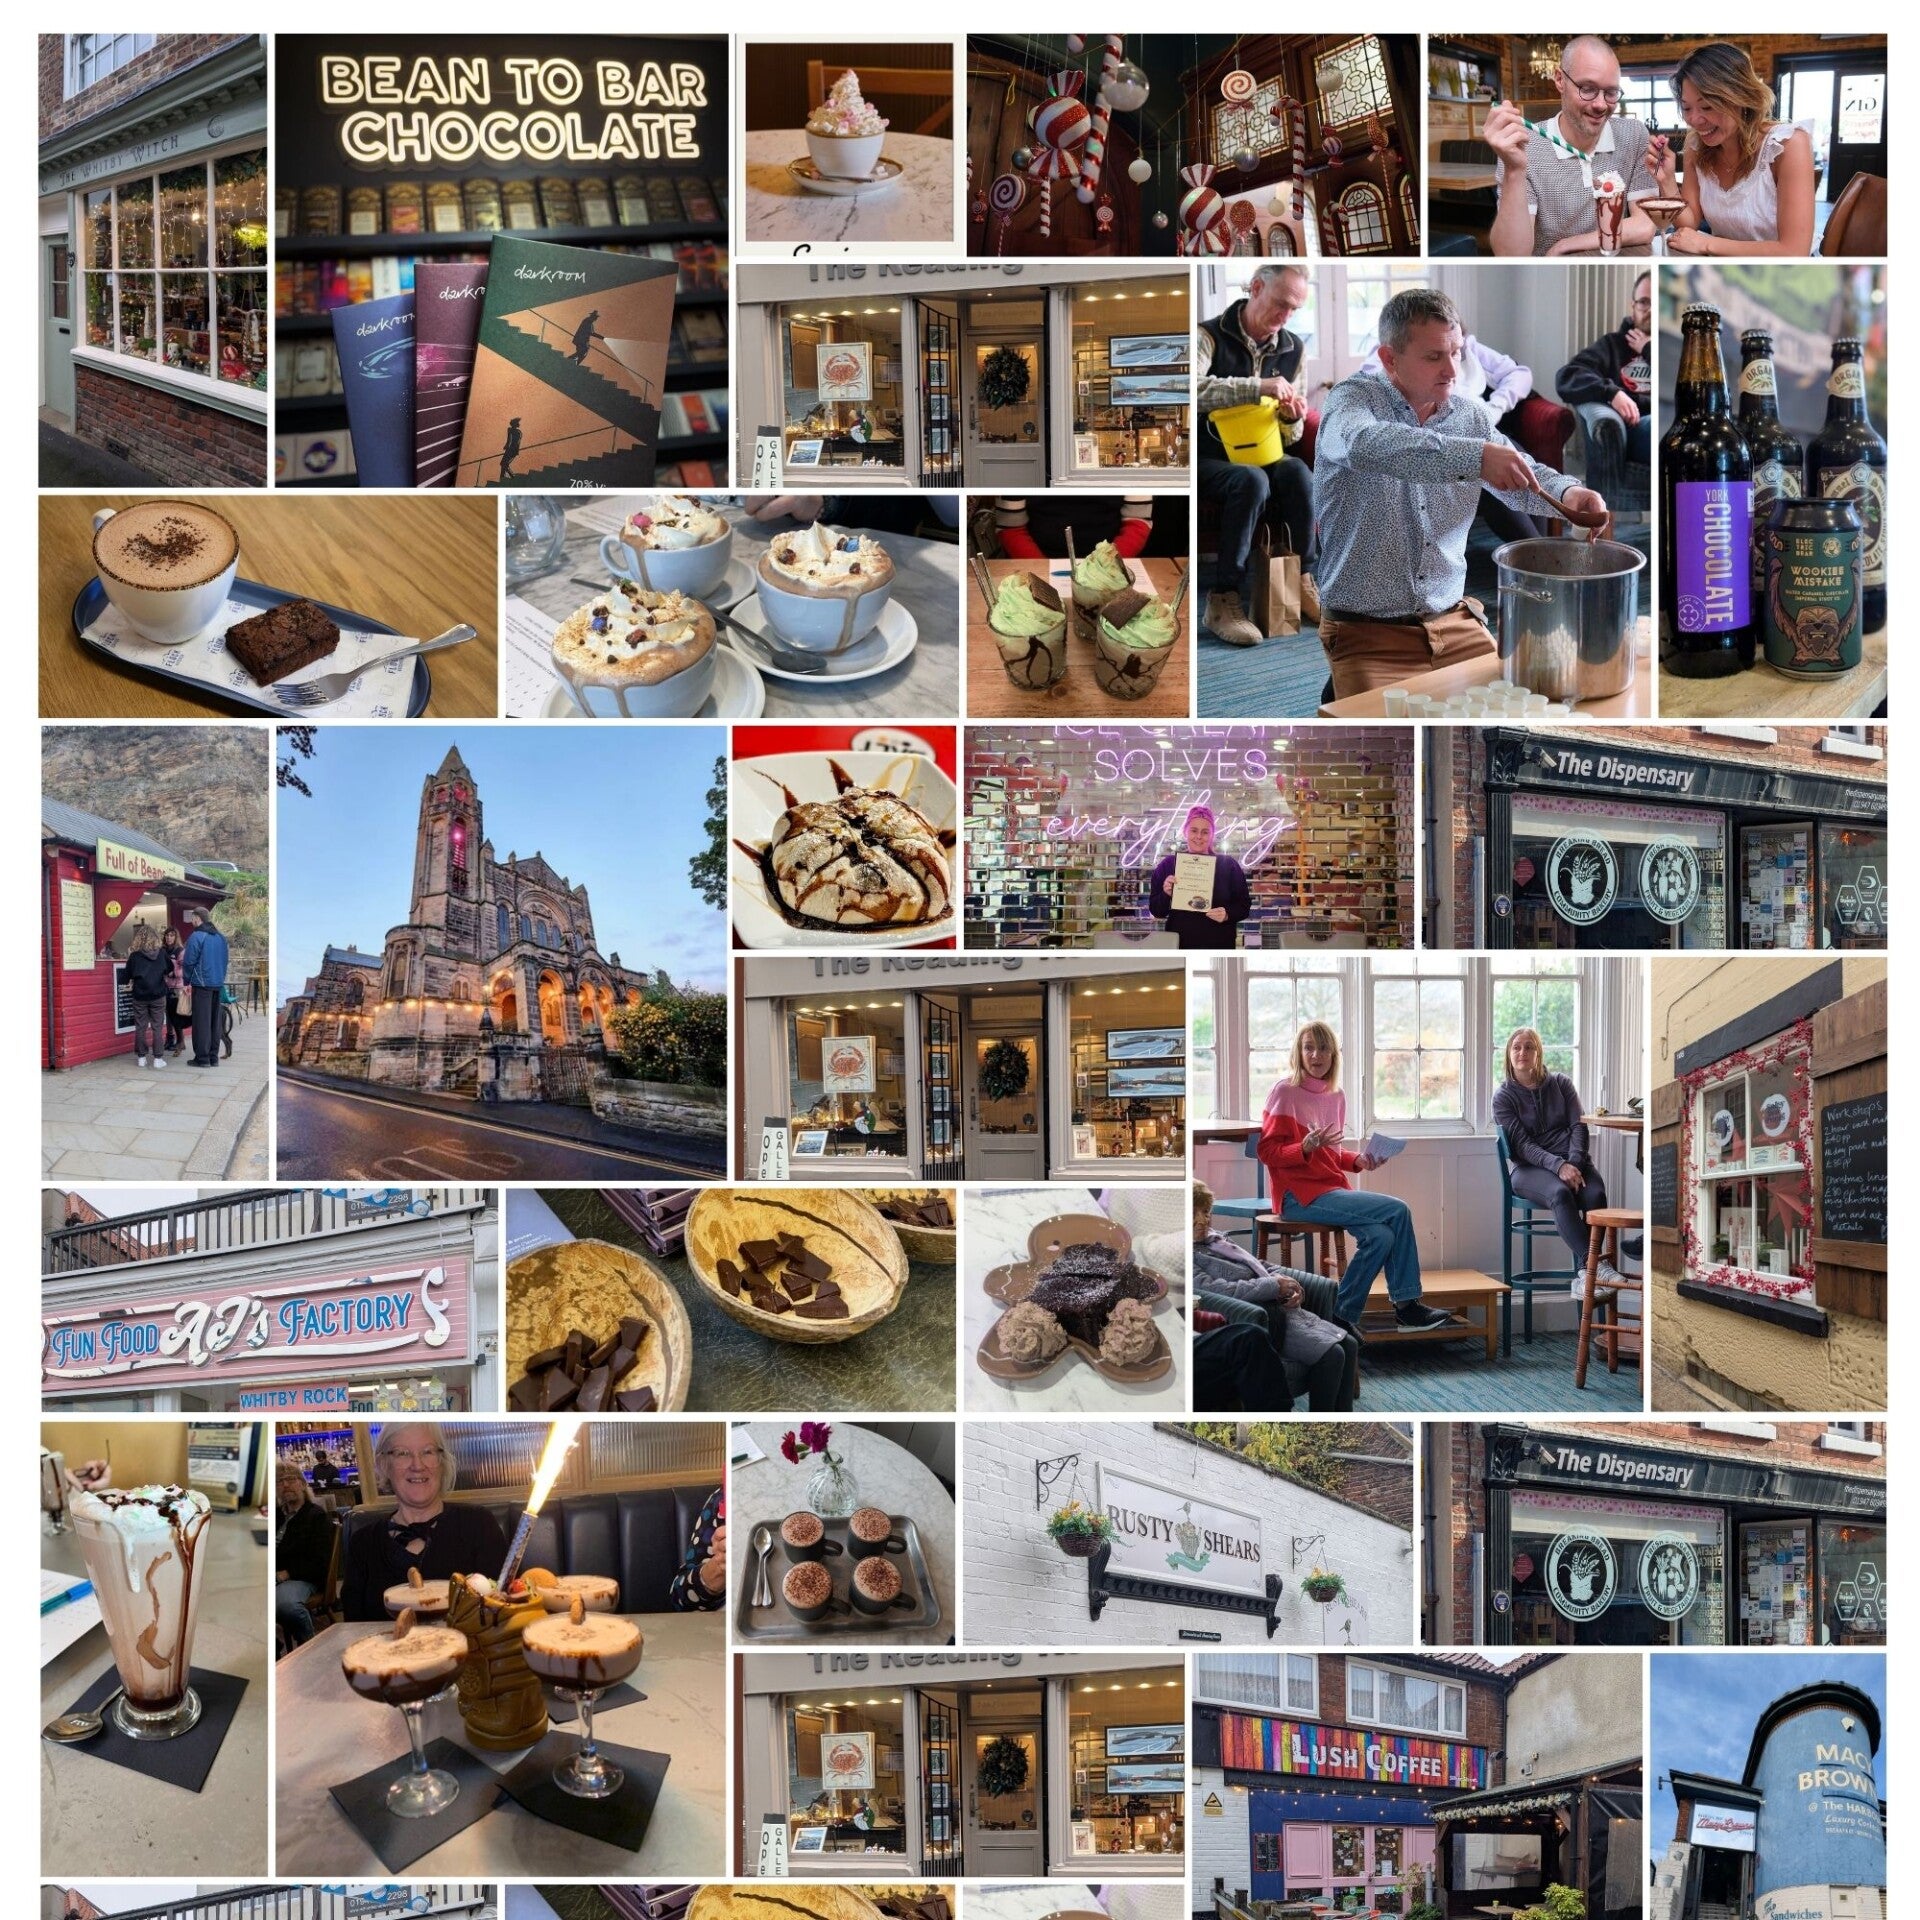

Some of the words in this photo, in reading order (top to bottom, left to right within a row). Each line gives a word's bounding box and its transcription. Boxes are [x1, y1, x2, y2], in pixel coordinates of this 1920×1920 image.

[321, 55, 491, 105] BEAN
[504, 57, 584, 106] TO
[596, 60, 708, 107] BAR
[340, 110, 701, 163] CHOCOLATE
[60, 171, 76, 187] THE
[82, 154, 124, 177] WHITBY
[130, 134, 179, 162] WITCH
[513, 264, 586, 283] darkroom
[1706, 489, 1729, 502] YORK
[1703, 503, 1734, 625] CHOCOLATE
[1794, 577, 1842, 586] MISTAKE
[1093, 748, 1269, 782] SOLVES
[1557, 751, 1593, 777] The
[1596, 756, 1695, 792] Dispensary
[105, 847, 125, 871] Full
[127, 856, 139, 874] of
[1592, 839, 1611, 865] BREAD
[1553, 890, 1591, 921] COMMUNITY
[1592, 888, 1612, 919] BAKERY
[52, 1327, 96, 1368] FUN
[100, 1320, 160, 1363] FOOD
[159, 1295, 271, 1367] AJ's
[278, 1291, 414, 1346] FACTORY
[240, 1390, 298, 1409] WHITBY
[303, 1387, 348, 1405] ROCK
[1556, 1447, 1590, 1474] The
[1595, 1452, 1694, 1488] Dispensary
[1106, 1504, 1173, 1543] RUSTY
[1203, 1529, 1261, 1563] SHEARS
[1591, 1535, 1610, 1562] BREAD
[1552, 1587, 1590, 1616] COMMUNITY
[1590, 1584, 1612, 1614] BAKERY
[1291, 1734, 1359, 1769] LUSH
[1366, 1744, 1442, 1777] COFFEE
[1816, 1744, 1872, 1773] MACY
[1808, 1802, 1818, 1812] @
[1822, 1801, 1844, 1811] The
[1824, 1814, 1856, 1826] Luxury
[1770, 1908, 1824, 1920] Sandwiches
